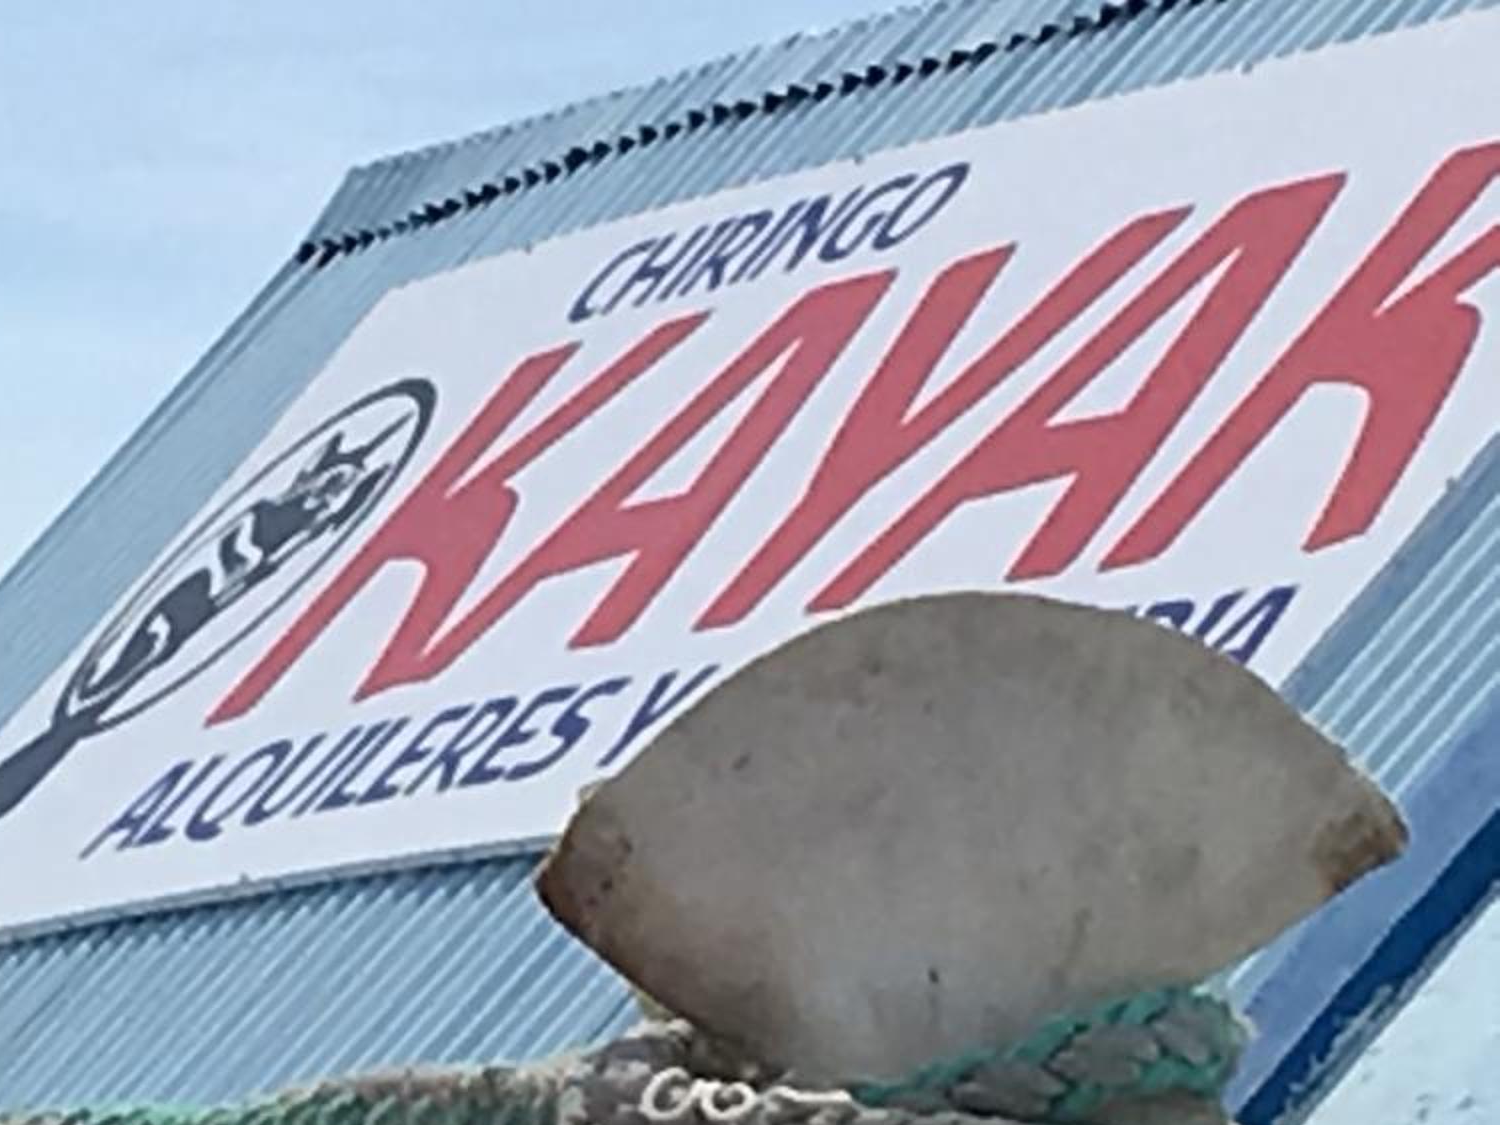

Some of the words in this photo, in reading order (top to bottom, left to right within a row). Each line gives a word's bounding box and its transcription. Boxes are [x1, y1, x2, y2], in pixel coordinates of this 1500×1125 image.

[567, 161, 972, 323] CHIRINGO
[204, 139, 1500, 728] KAYAK
[79, 675, 633, 860] ALQUILERES
[597, 662, 722, 769] Y
